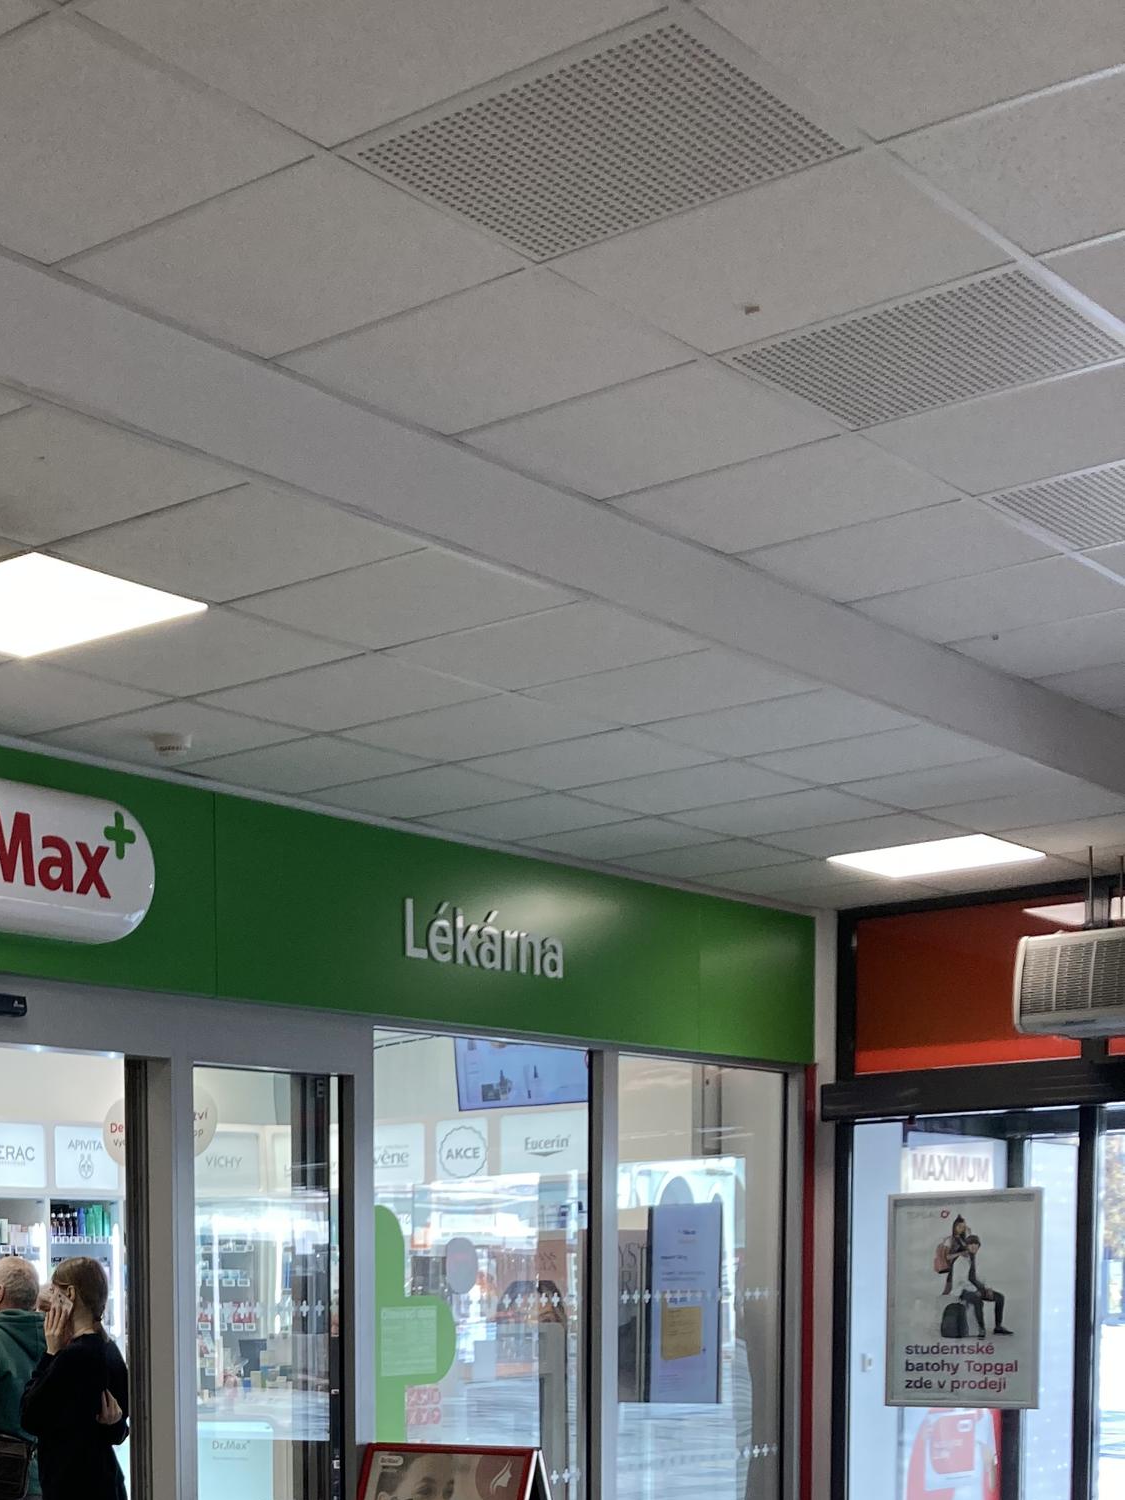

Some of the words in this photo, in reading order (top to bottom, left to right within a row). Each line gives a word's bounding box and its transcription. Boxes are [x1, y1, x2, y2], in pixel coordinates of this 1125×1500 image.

[403, 897, 565, 980] Lékárna
[68, 1139, 103, 1151] APIVITA
[445, 1147, 480, 1160] AKCE
[205, 1155, 243, 1169] VICHY
[912, 1152, 990, 1183] MAXIMUM
[905, 1342, 995, 1355] studentské
[905, 1360, 960, 1375] batohy
[964, 1360, 1018, 1376] Topgal
[905, 1377, 933, 1389] zde
[937, 1379, 947, 1389] v
[950, 1377, 1006, 1393] prodeji
